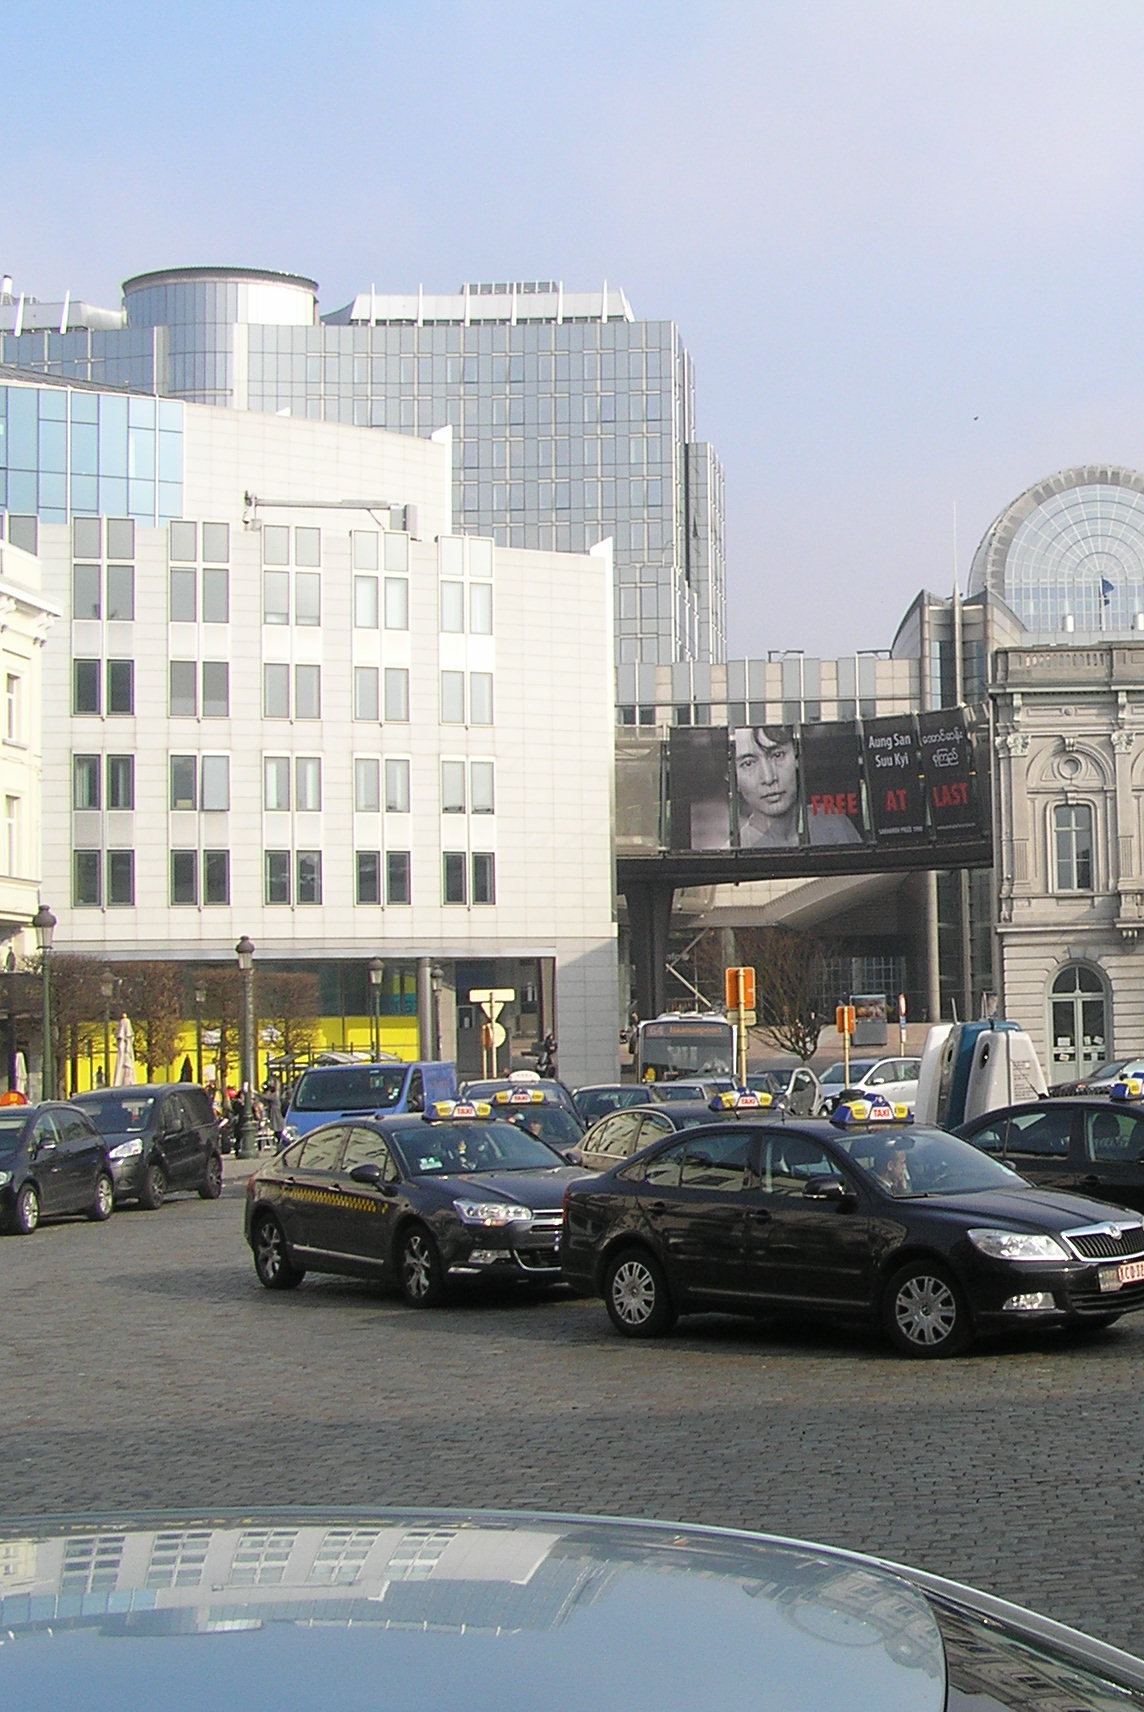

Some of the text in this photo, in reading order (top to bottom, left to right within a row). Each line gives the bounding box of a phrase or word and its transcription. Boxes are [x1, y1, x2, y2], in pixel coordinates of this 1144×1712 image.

[868, 733, 911, 750] Aung San
[875, 752, 909, 768] Suu Kyi
[810, 782, 969, 816] FREE AT LAST
[741, 1098, 756, 1106] TAXI
[457, 1107, 473, 1116] TAXI
[873, 1108, 890, 1118] TAXI
